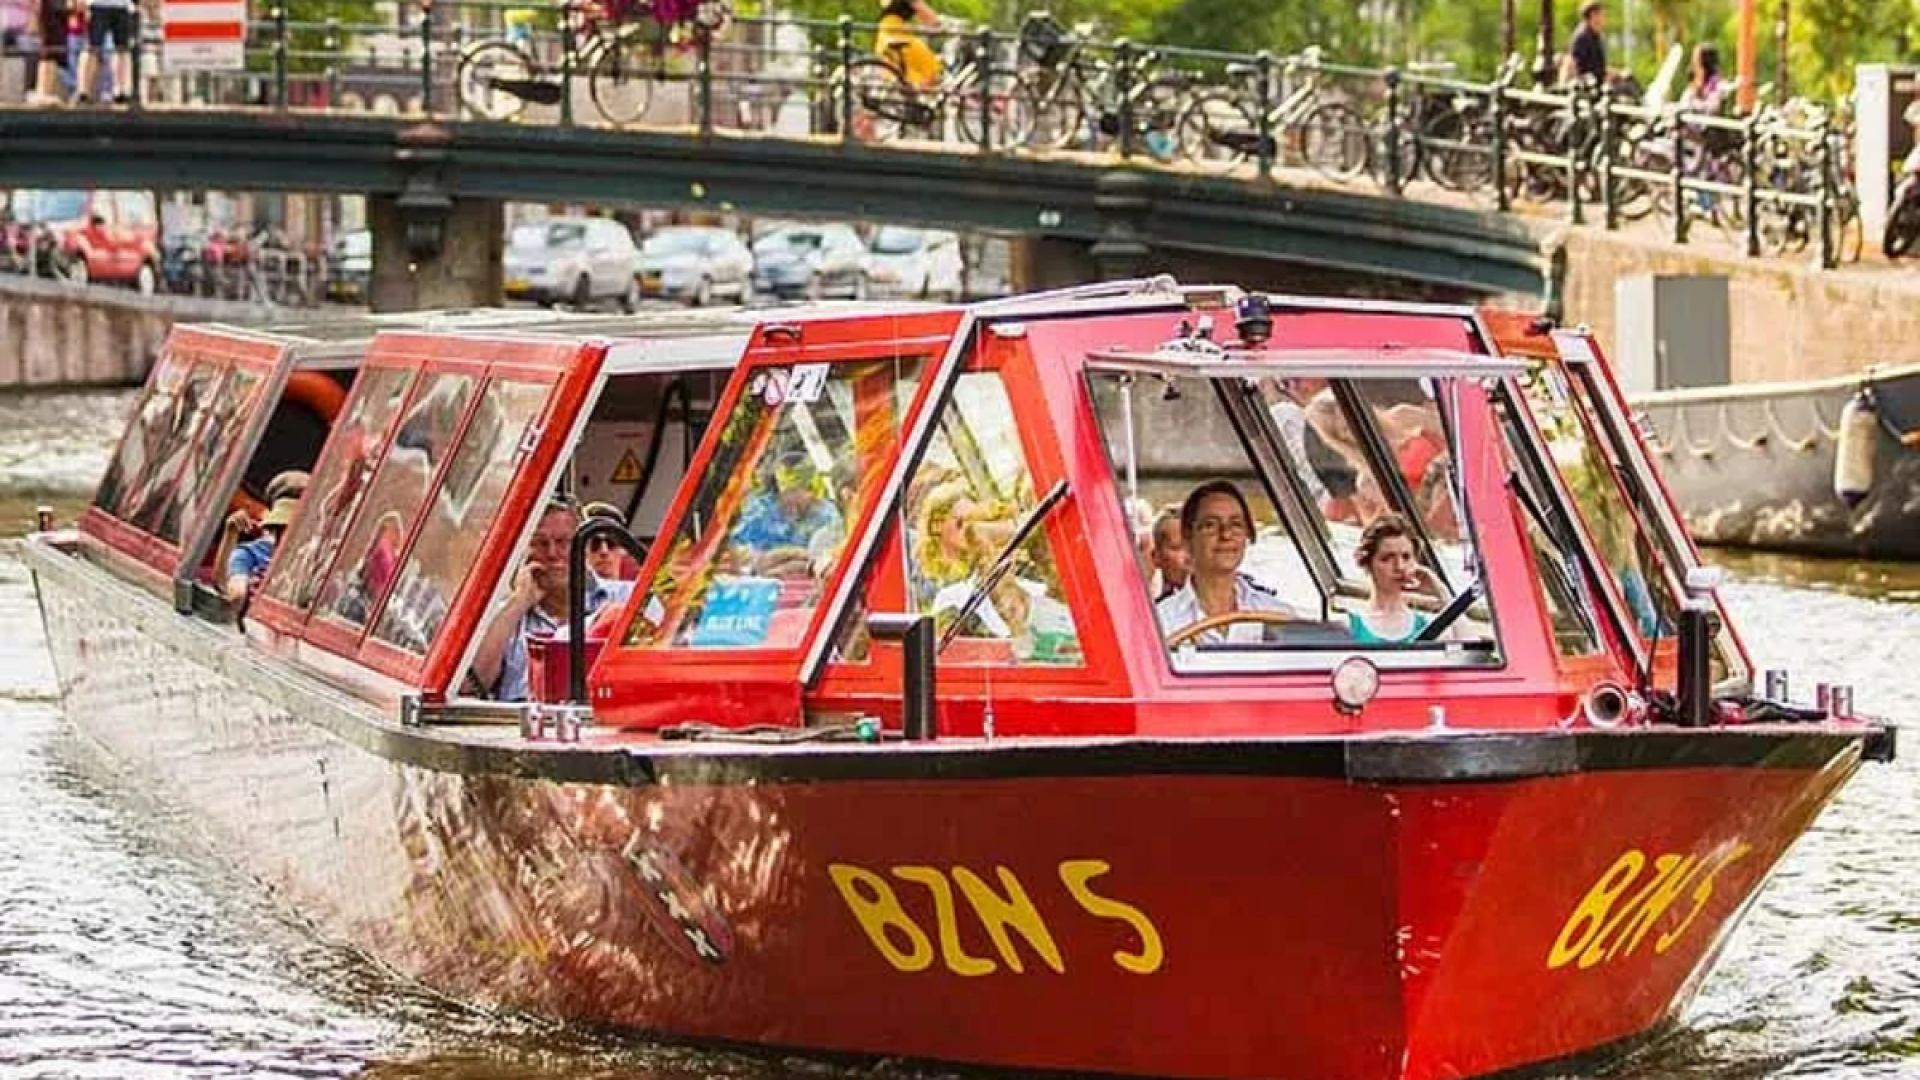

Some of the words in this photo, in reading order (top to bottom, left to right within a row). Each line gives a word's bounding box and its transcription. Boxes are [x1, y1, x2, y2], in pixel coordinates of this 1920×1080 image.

[828, 864, 1065, 975] BZN
[1058, 859, 1164, 974] 5
[1546, 849, 1712, 969] BZN
